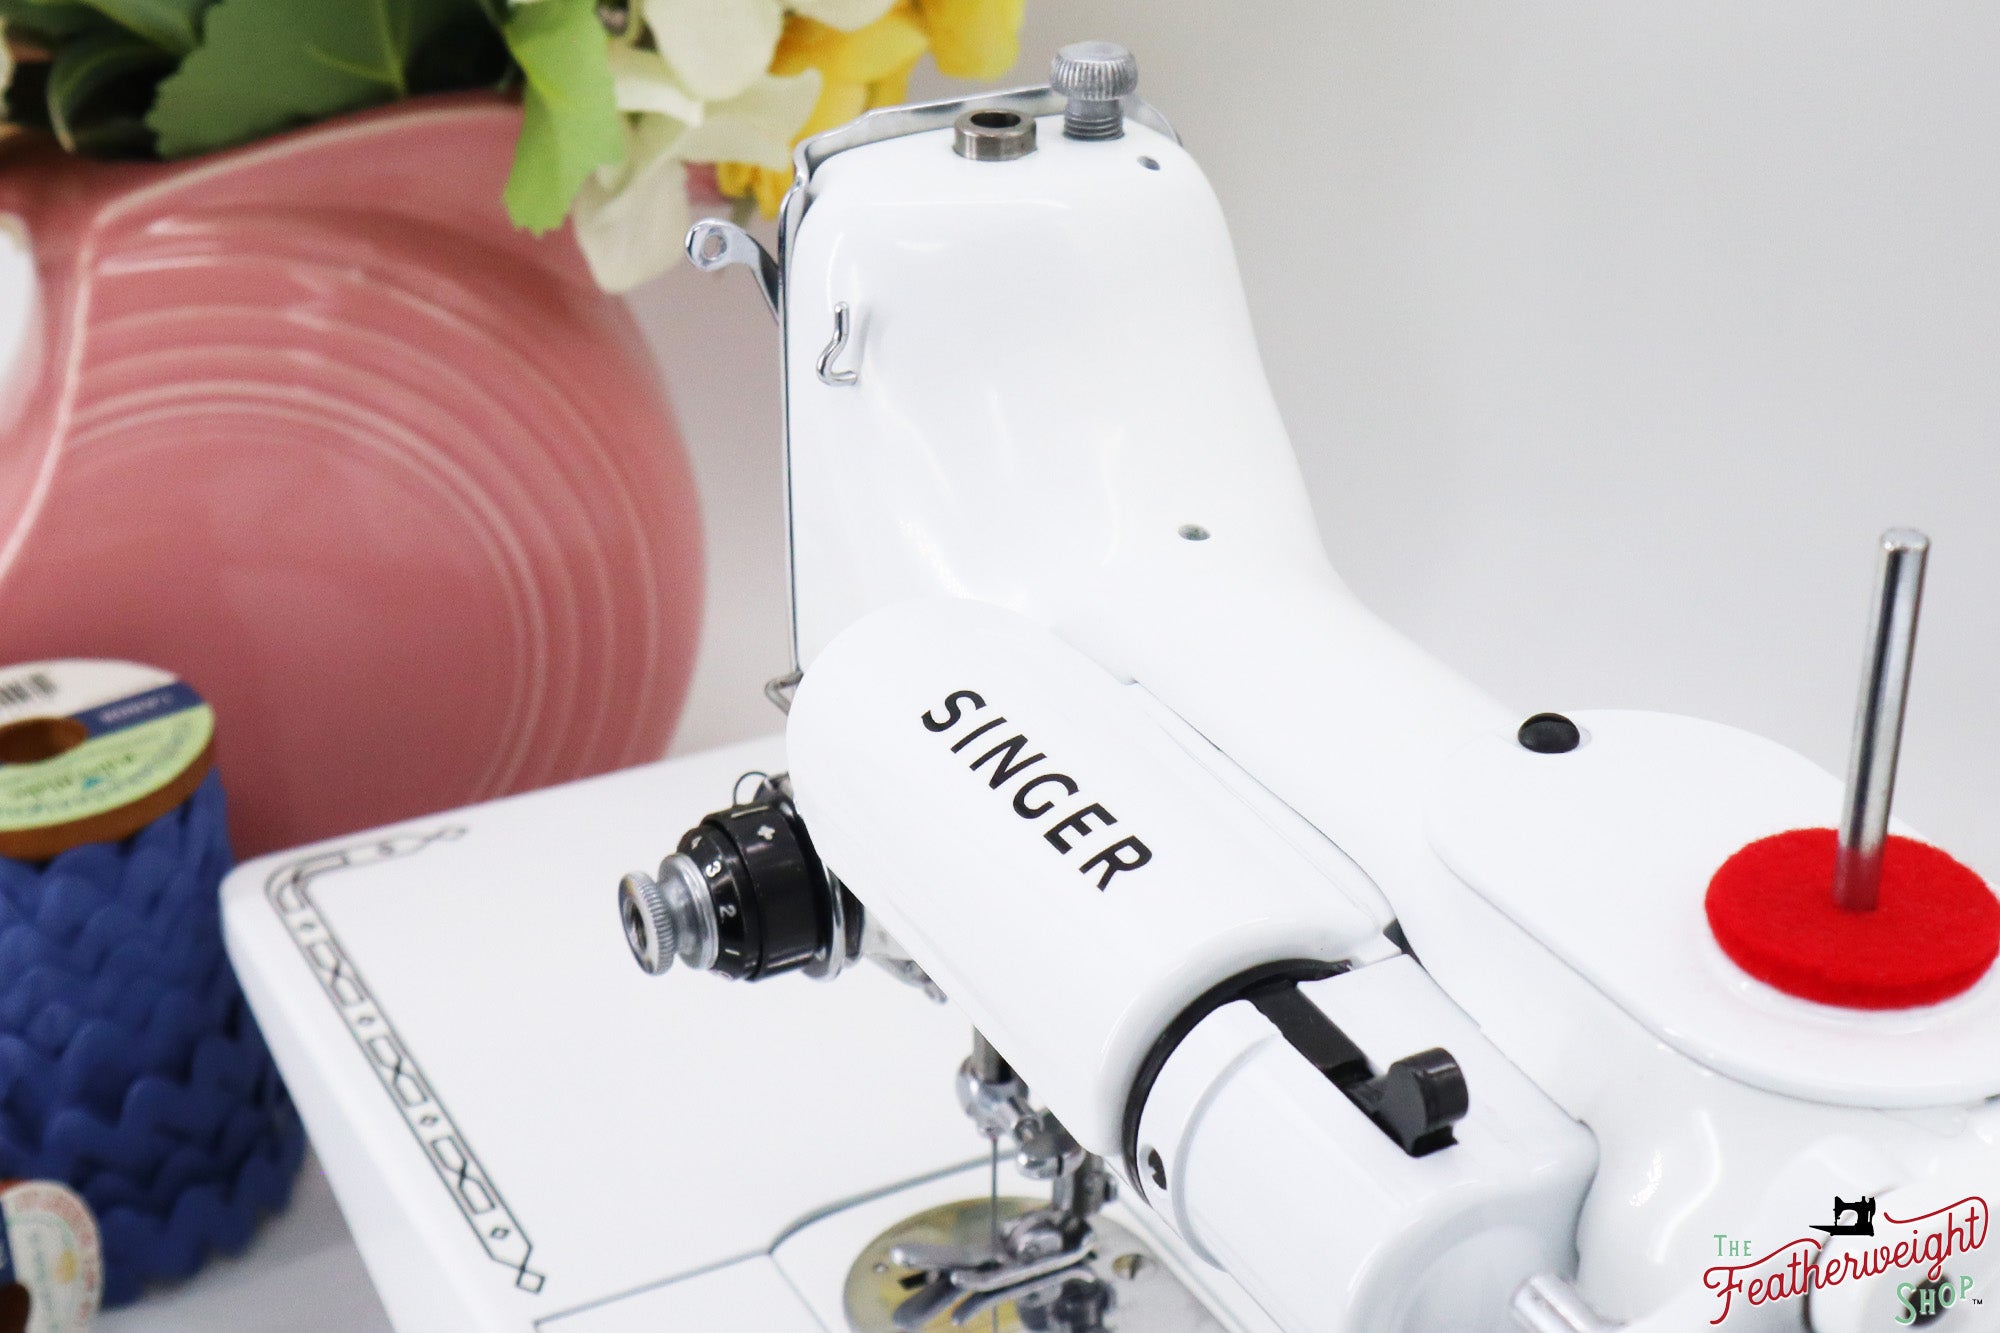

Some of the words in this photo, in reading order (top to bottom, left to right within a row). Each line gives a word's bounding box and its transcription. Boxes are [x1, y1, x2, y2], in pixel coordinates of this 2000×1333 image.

[921, 690, 1153, 892] SINGER
[705, 860, 721, 878] 3
[719, 904, 737, 919] 2
